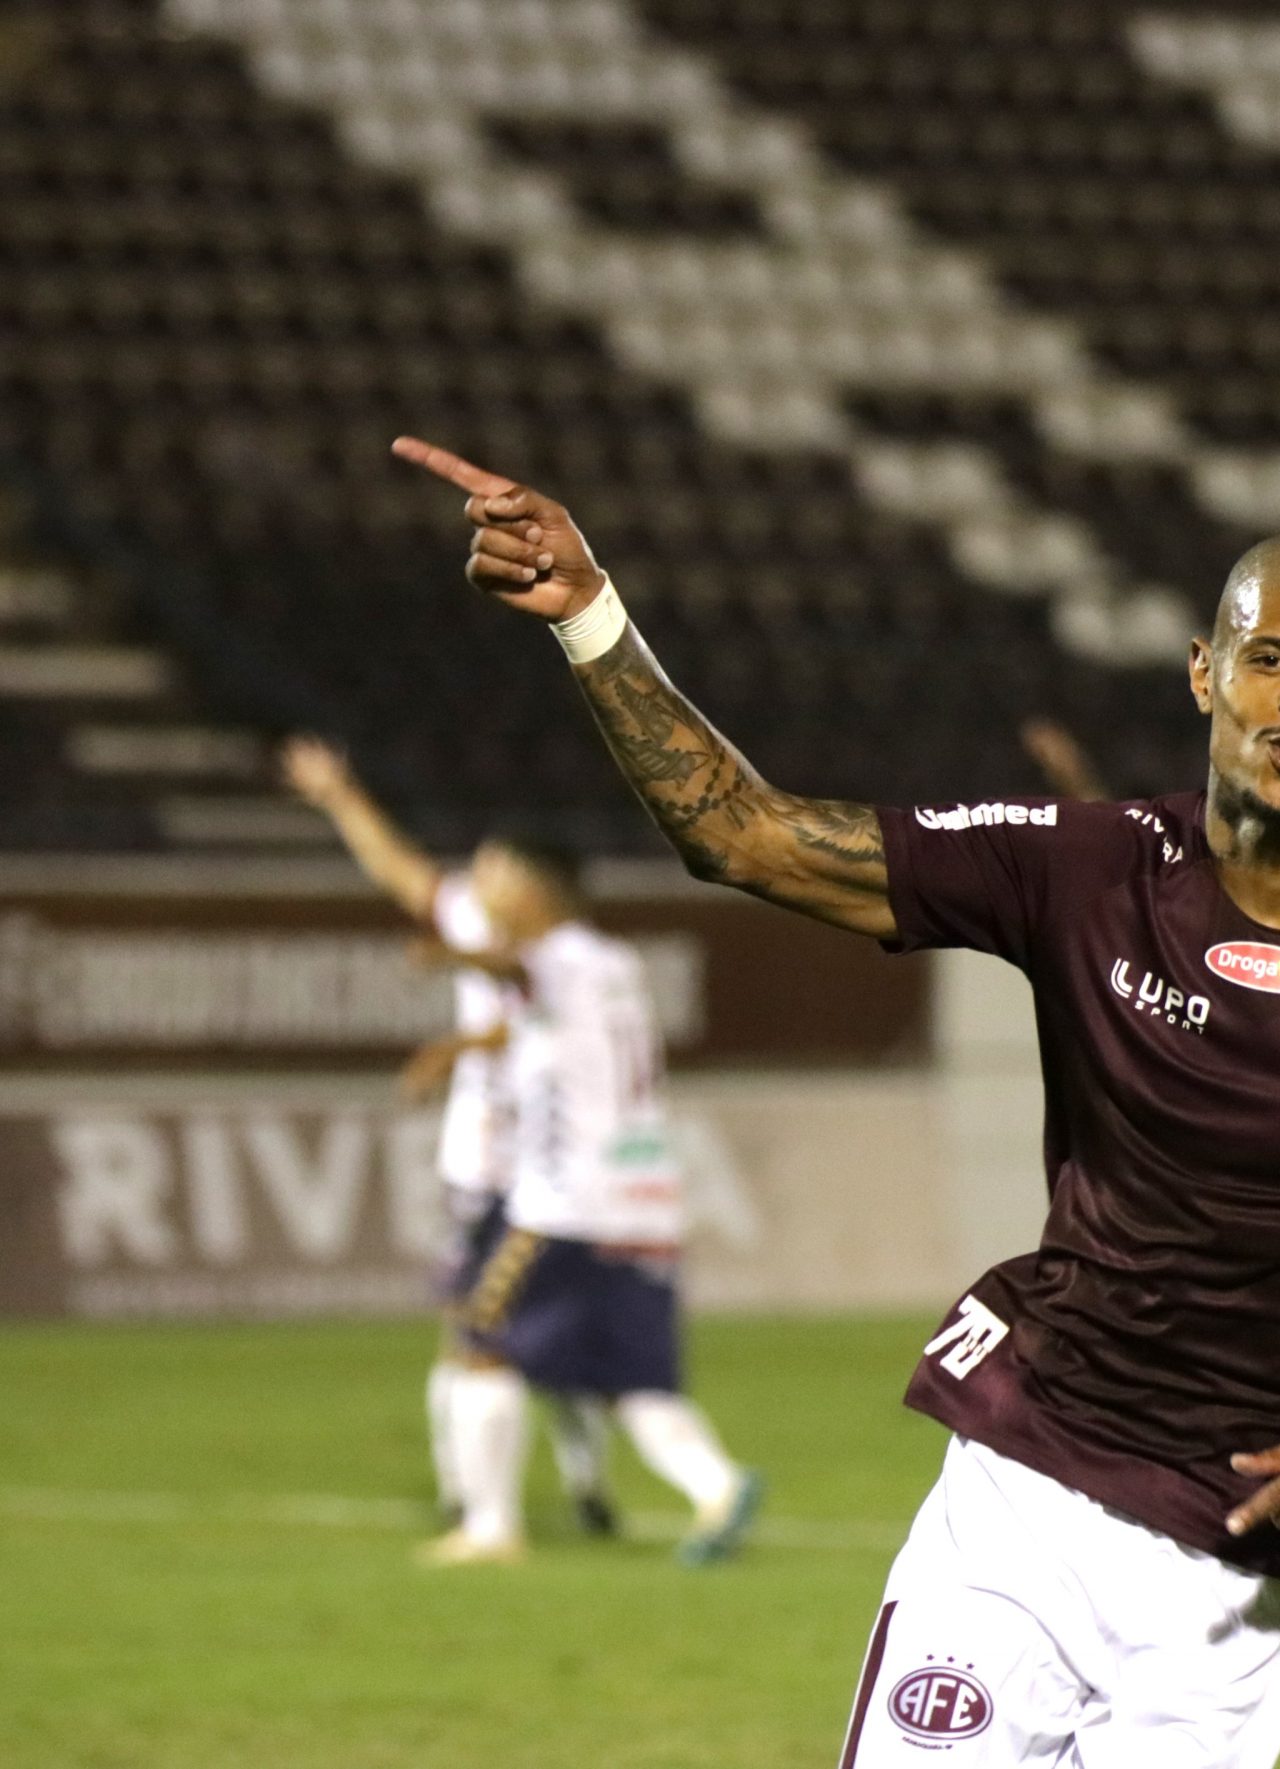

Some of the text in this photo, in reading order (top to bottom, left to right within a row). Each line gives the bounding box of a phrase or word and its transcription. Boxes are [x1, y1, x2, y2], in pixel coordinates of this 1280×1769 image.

[914, 802, 1057, 831] Unimed
[1124, 808, 1183, 864] RIVRA
[1110, 957, 1210, 1025] LUPO
[1134, 1000, 1204, 1034] SPORT
[899, 1677, 978, 1729] AFE
